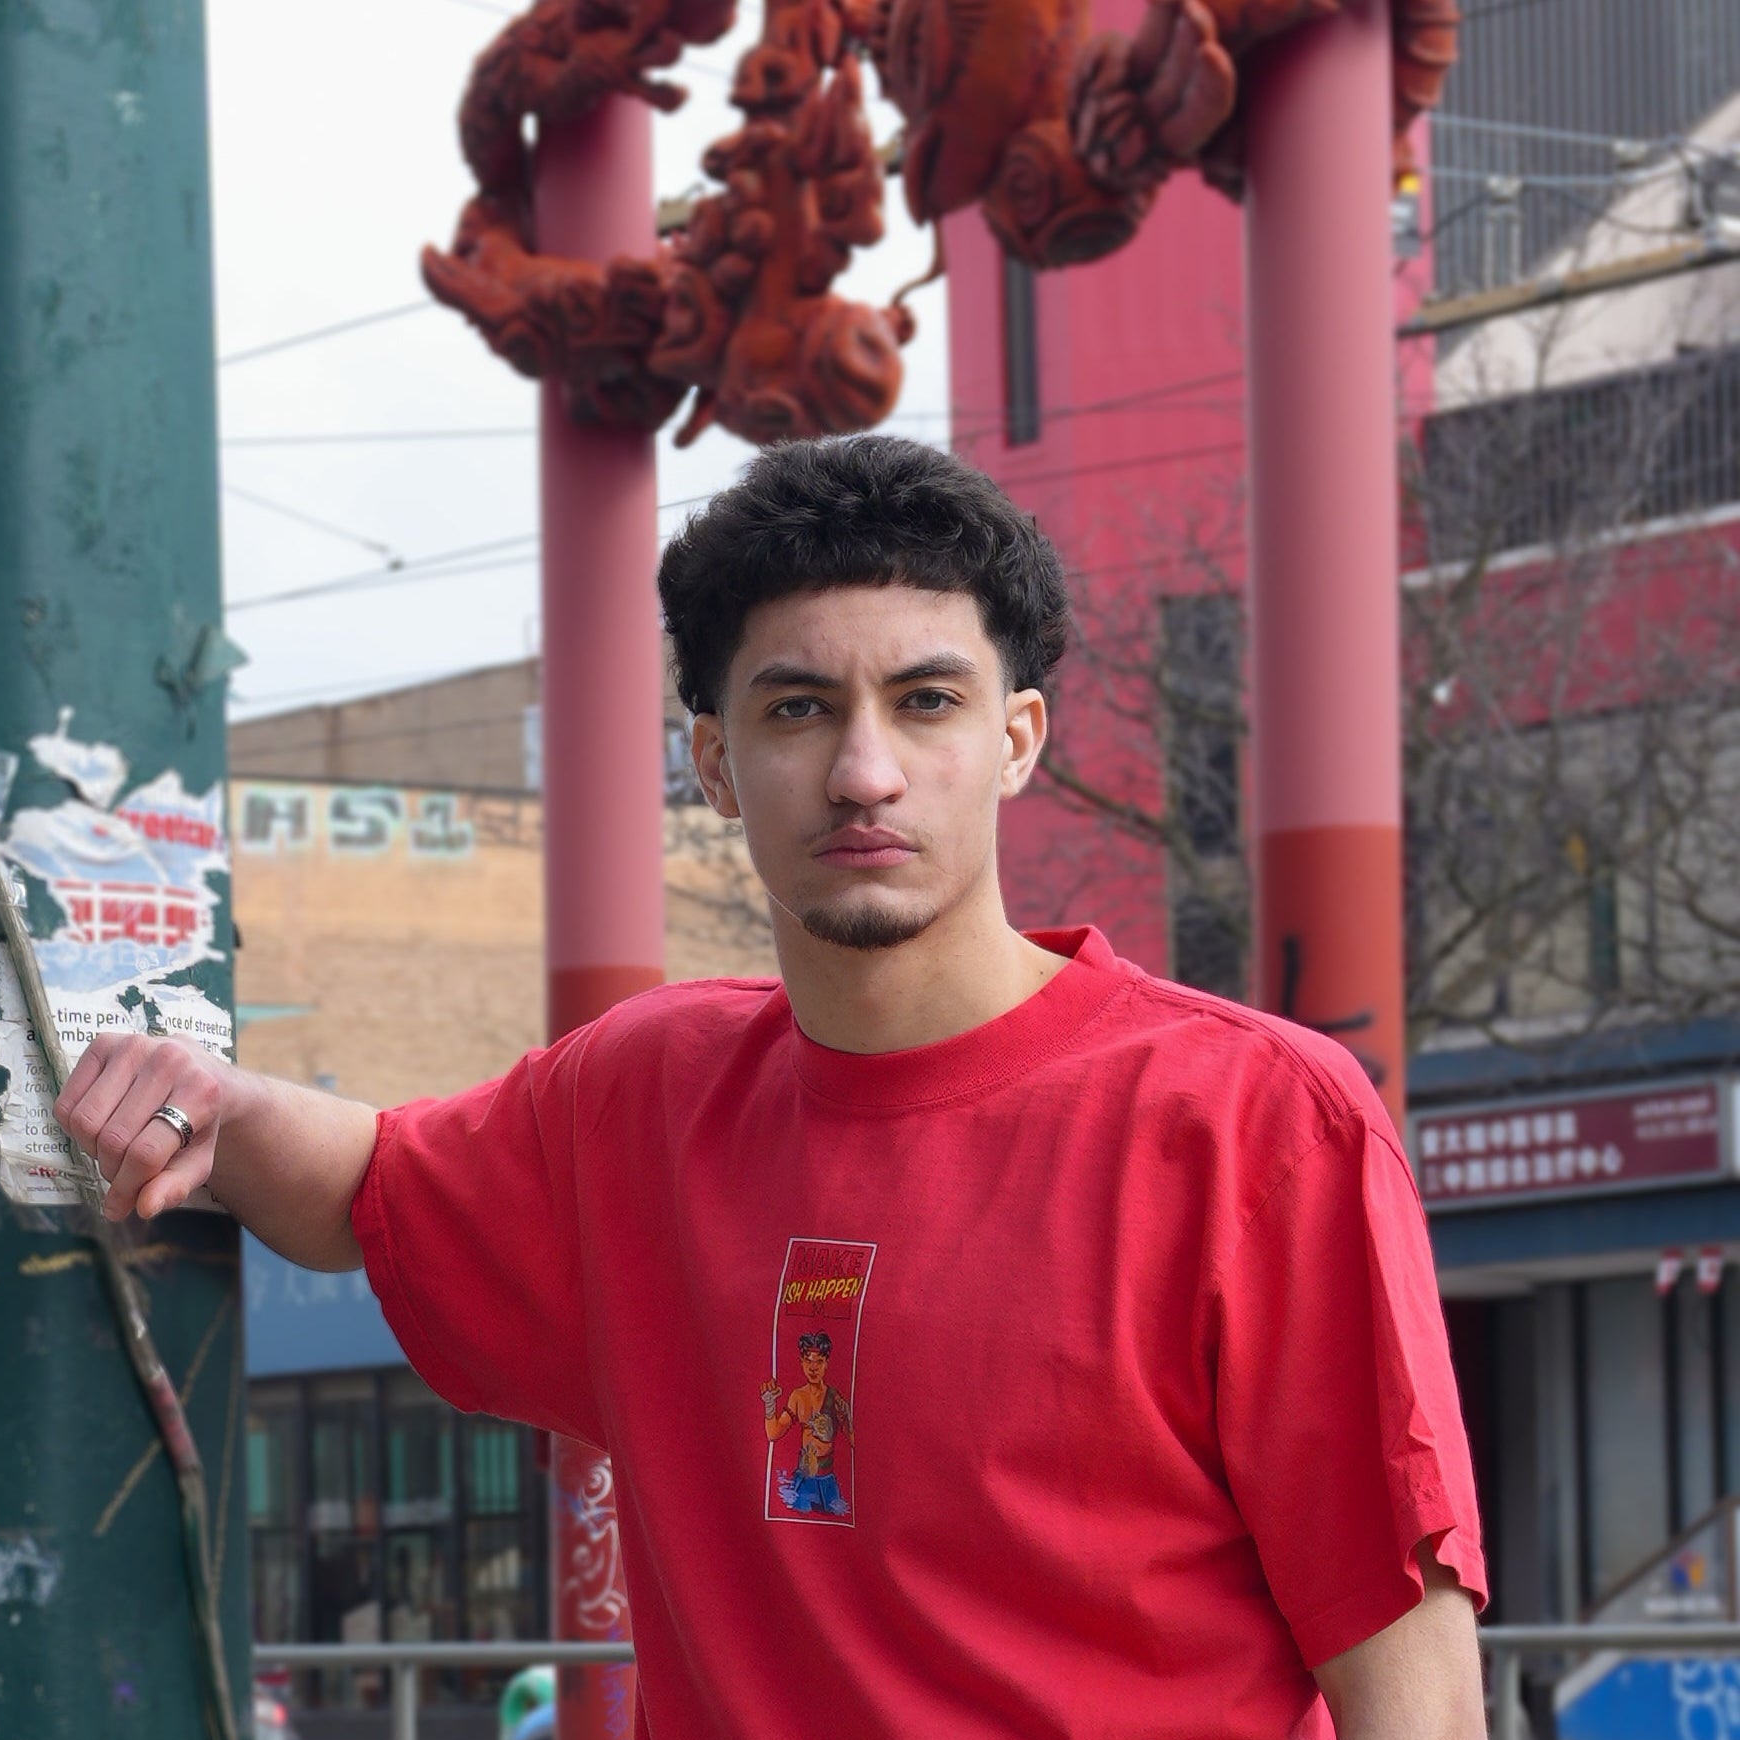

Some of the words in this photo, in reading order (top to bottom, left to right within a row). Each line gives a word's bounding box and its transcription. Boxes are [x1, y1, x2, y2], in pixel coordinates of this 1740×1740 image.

[184, 1017, 193, 1030] of
[25, 1123, 39, 1136] to
[793, 1247, 864, 1277] MAKE
[783, 1282, 805, 1303] ISH
[807, 1277, 862, 1300] HAPPEN
